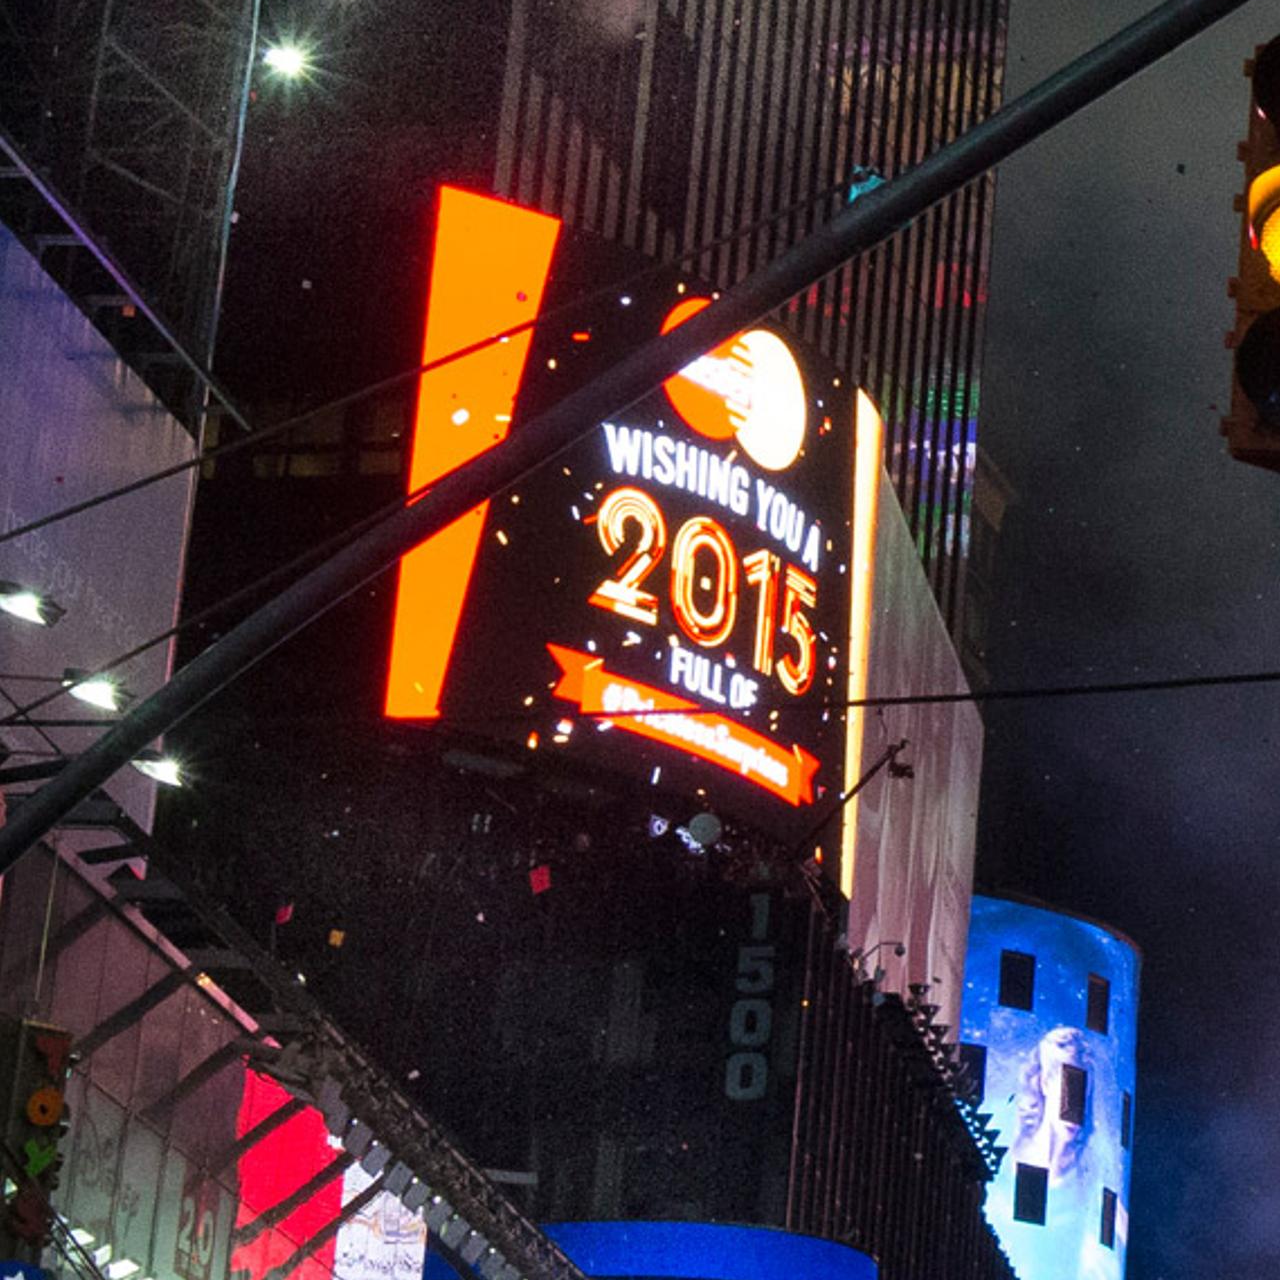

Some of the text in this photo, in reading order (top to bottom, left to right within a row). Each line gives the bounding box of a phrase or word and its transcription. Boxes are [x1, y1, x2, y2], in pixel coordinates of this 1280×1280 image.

[602, 422, 821, 572] WISHING YOU A
[588, 486, 818, 696] 2015
[671, 647, 758, 709] FULL OF
[725, 893, 776, 1101] 1500
